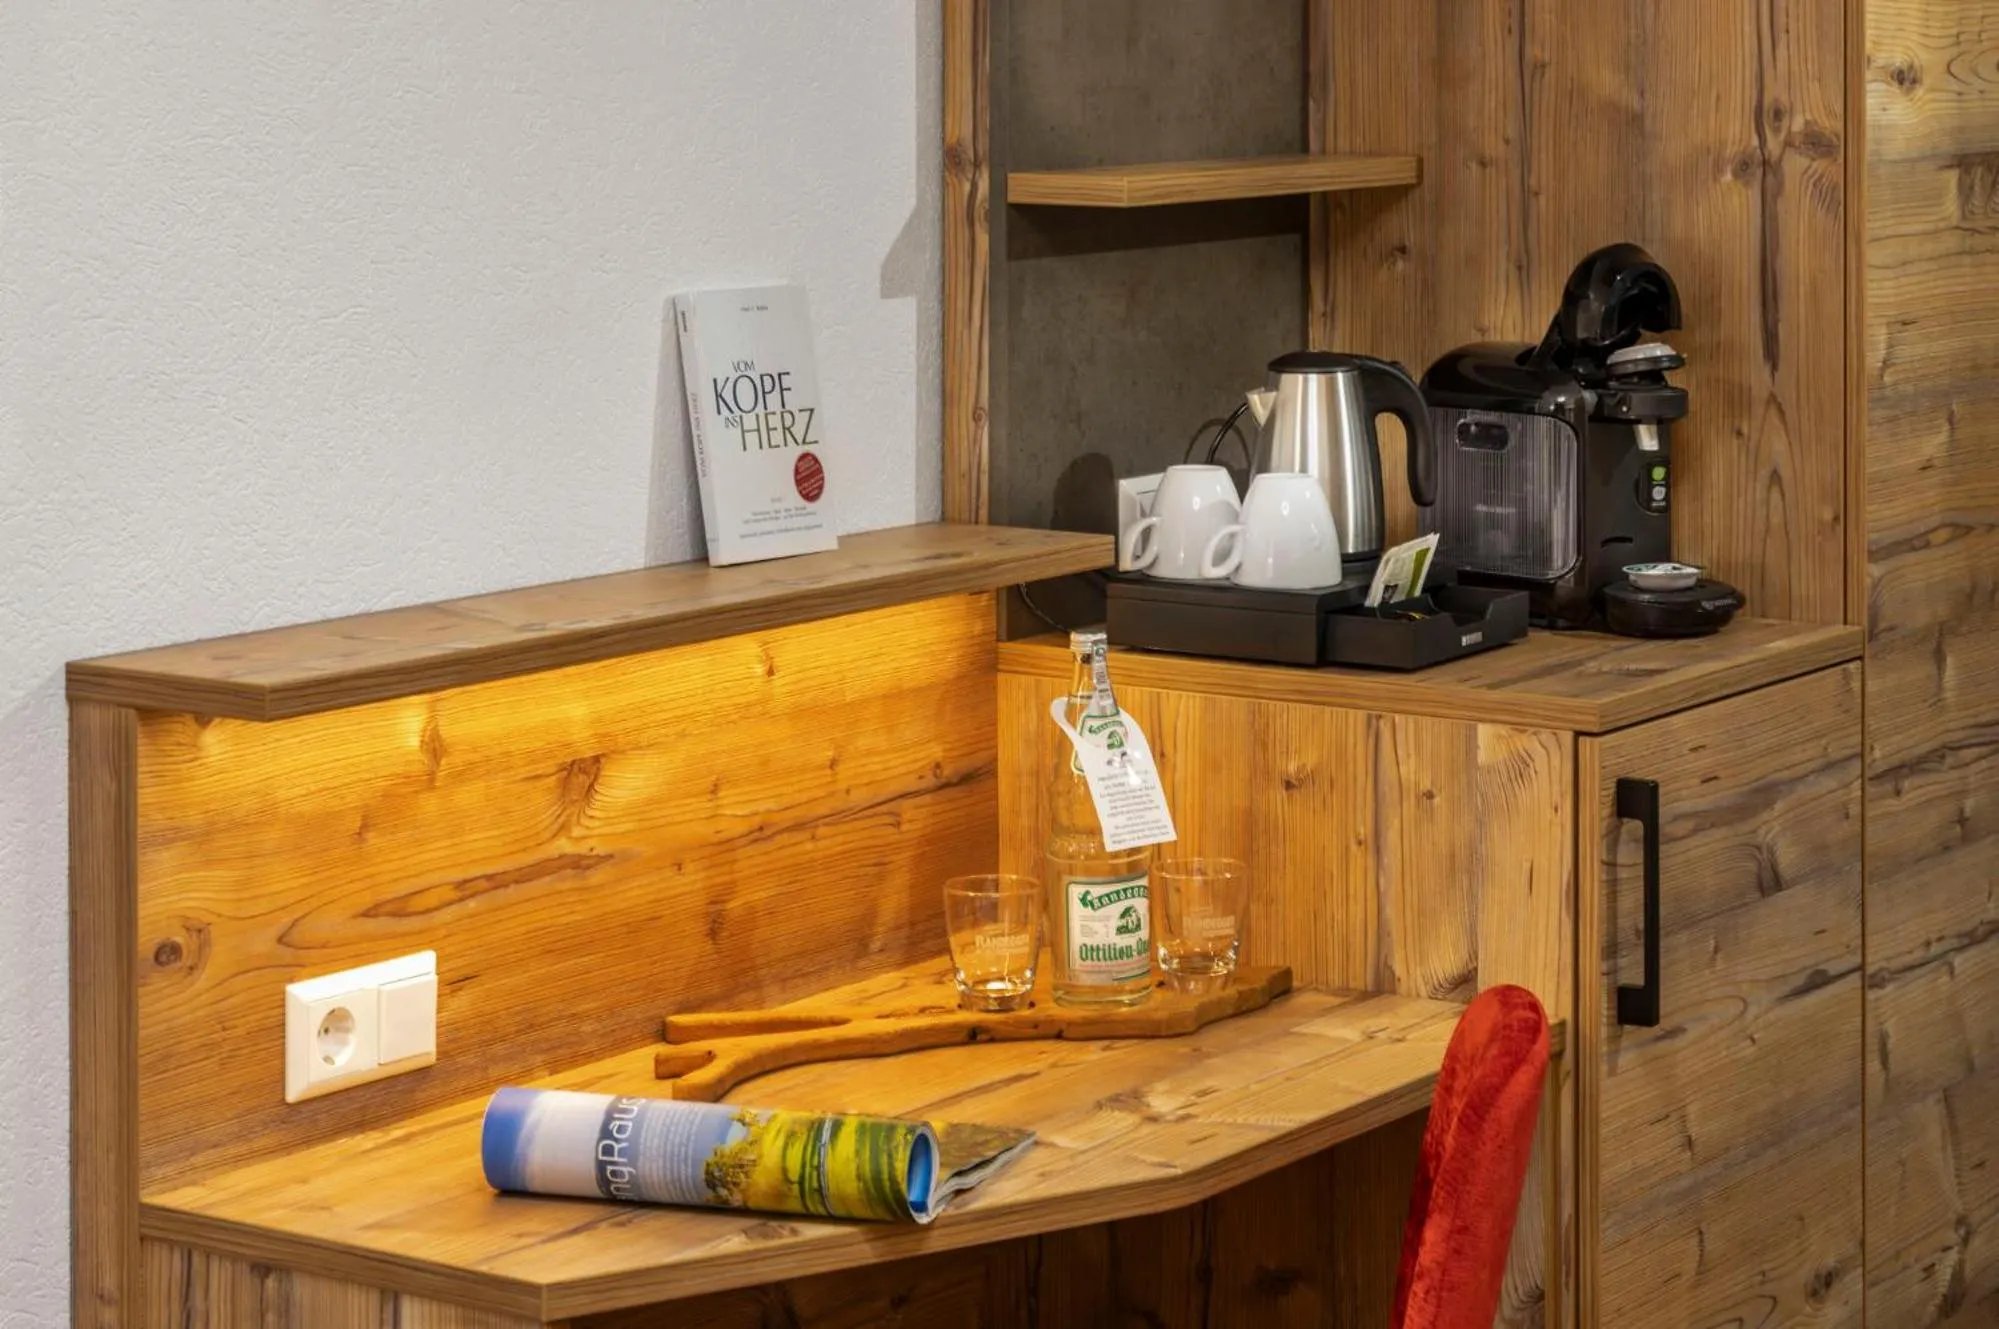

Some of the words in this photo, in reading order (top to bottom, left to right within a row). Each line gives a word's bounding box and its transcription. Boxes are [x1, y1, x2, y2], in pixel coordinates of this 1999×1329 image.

[731, 359, 756, 373] VOM
[712, 371, 792, 416] KOPF
[738, 408, 819, 452] HERZ
